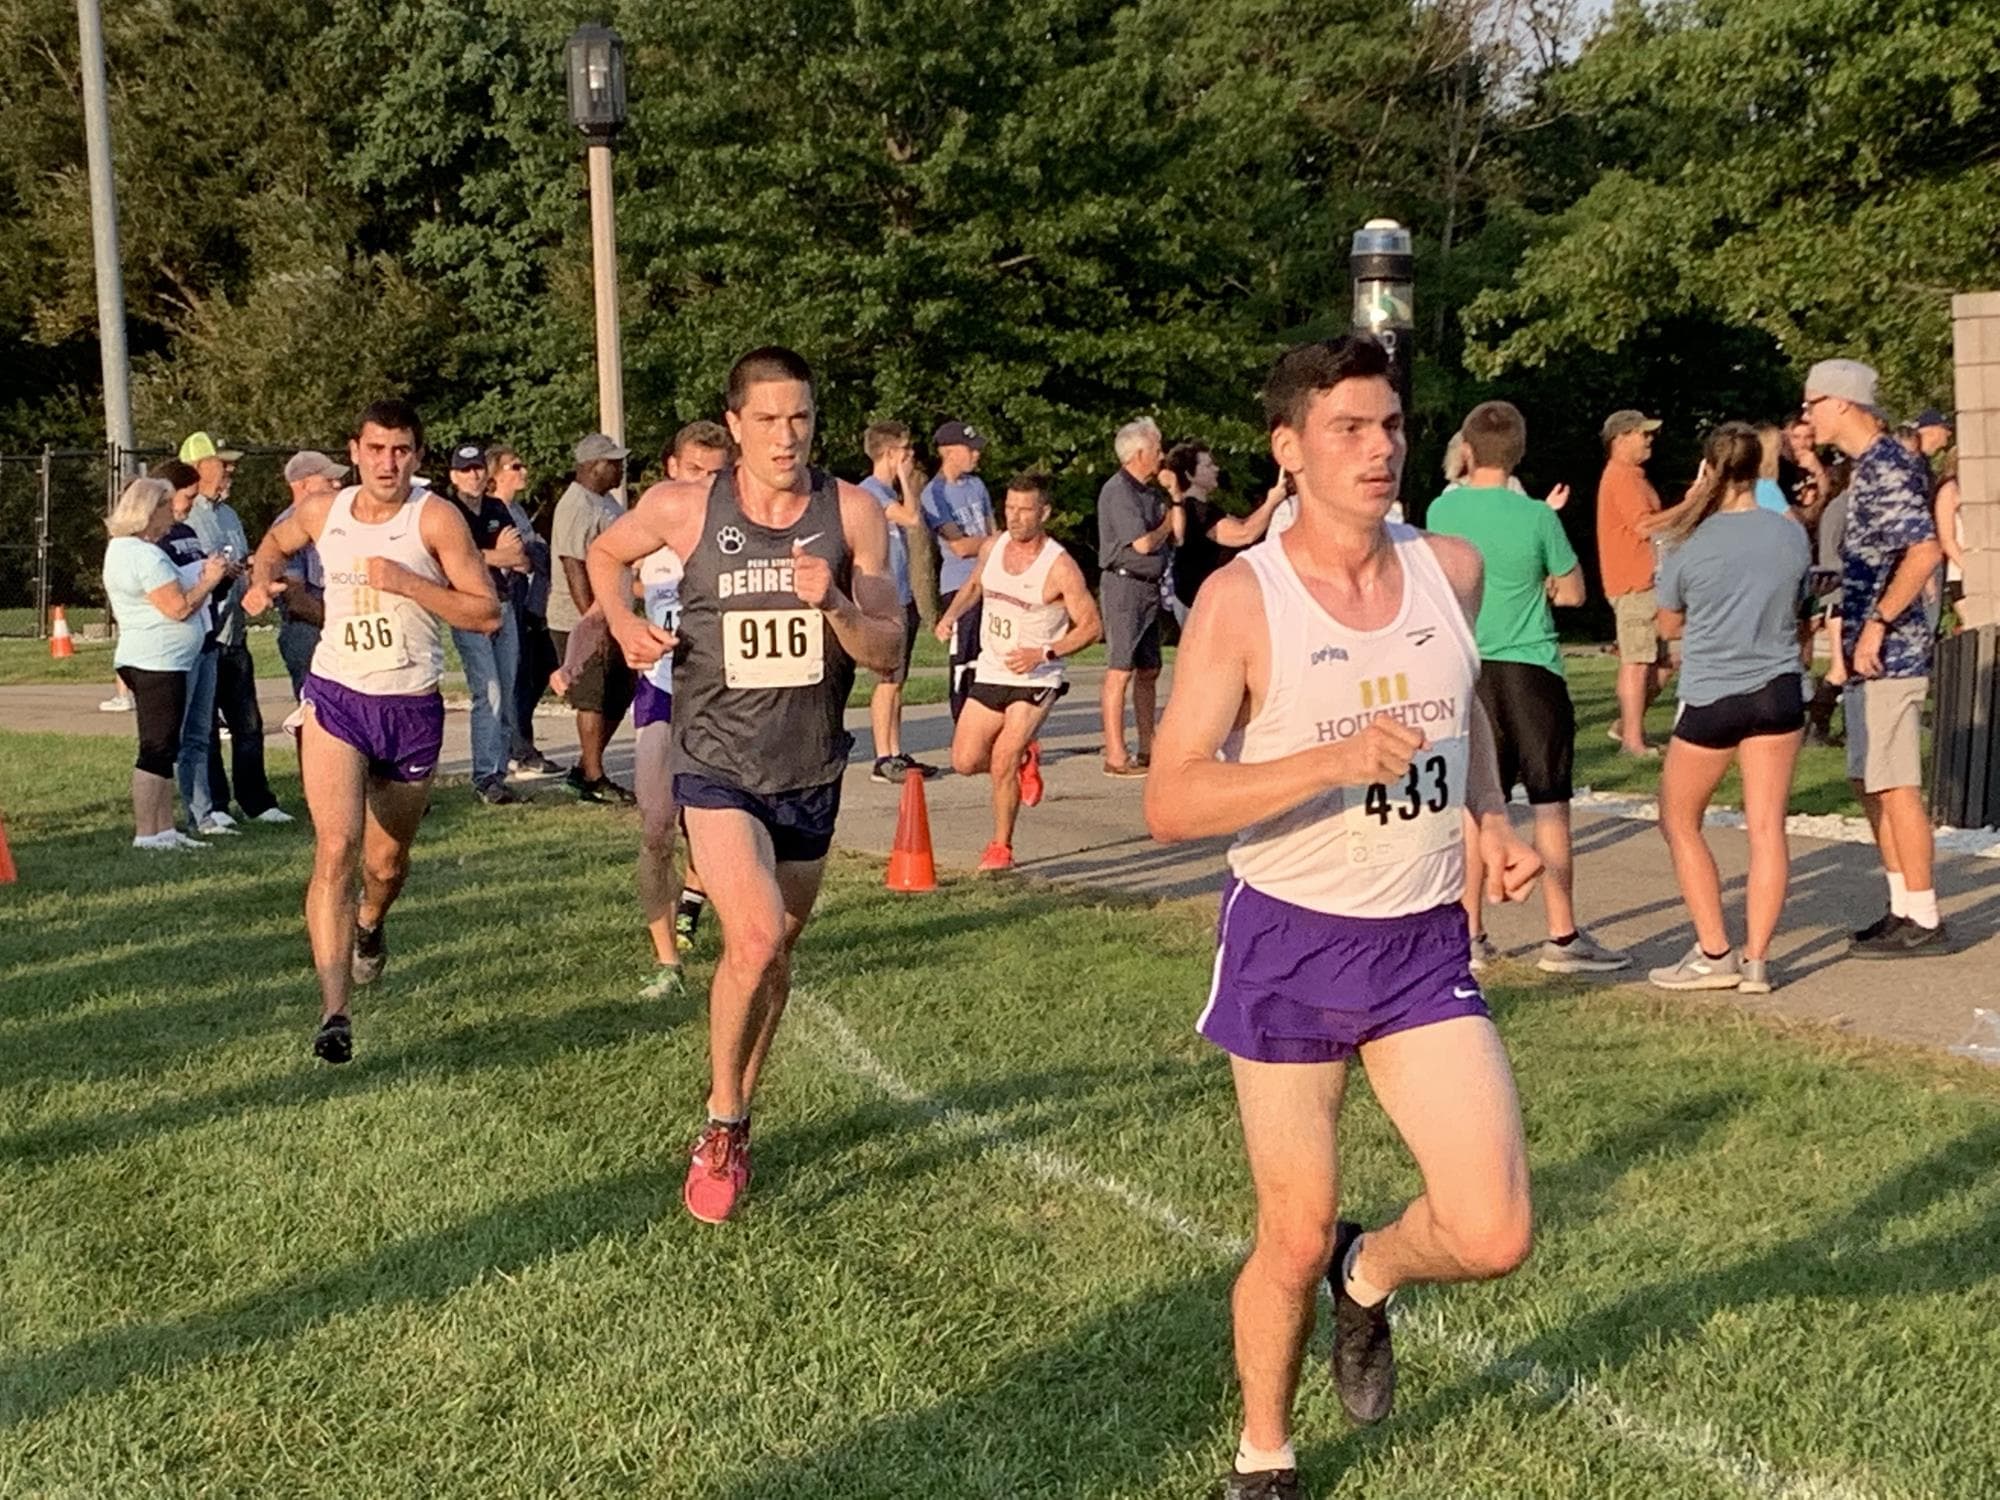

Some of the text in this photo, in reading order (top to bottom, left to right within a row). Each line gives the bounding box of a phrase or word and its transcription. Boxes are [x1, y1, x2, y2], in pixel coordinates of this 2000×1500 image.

[718, 567, 797, 599] BEHRE
[344, 617, 393, 652] 436
[739, 617, 808, 660] 916
[988, 612, 1012, 640] 293
[1364, 755, 1449, 826] 433
